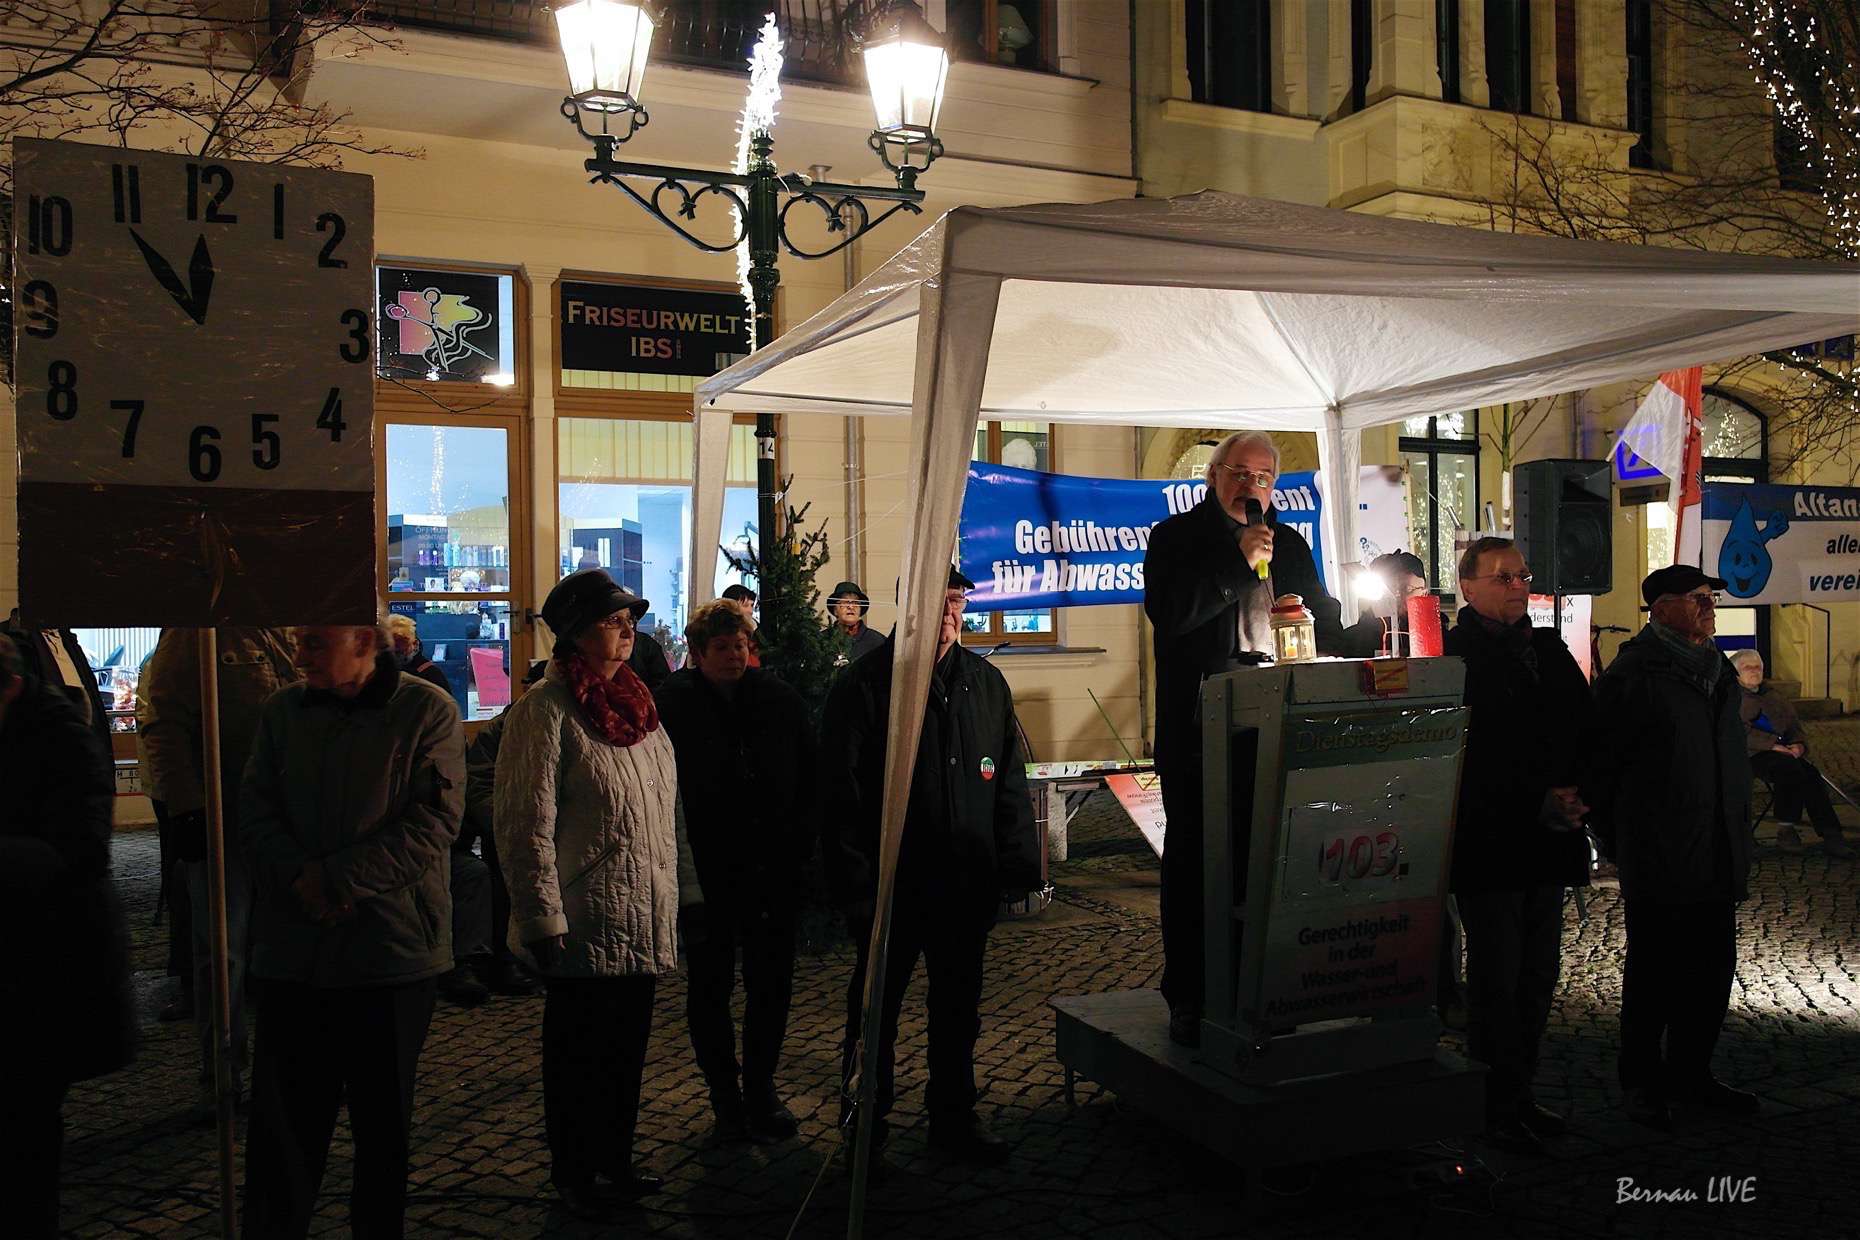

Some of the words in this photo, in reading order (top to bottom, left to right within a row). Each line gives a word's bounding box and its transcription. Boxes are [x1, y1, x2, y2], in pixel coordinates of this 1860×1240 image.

[112, 163, 141, 223] 11
[186, 163, 237, 223] 12
[274, 183, 284, 239] 1
[29, 193, 73, 256] 10
[316, 212, 348, 268] 2
[22, 280, 59, 339] 9
[339, 309, 370, 363] 3
[567, 301, 741, 334] FRISEURWELT
[47, 360, 77, 420] 8
[316, 387, 347, 442] 4
[110, 400, 144, 458] 7
[188, 426, 221, 482] 6
[252, 414, 281, 470] 5
[1270, 485, 1316, 512] ent
[1793, 491, 1860, 517] Altan
[1015, 519, 1160, 554] Gebühren
[1826, 534, 1860, 555] alle
[992, 559, 1036, 594] für
[1040, 558, 1145, 592] Abwass
[1298, 914, 1410, 945] Gerechtigkeit
[1328, 946, 1345, 962] in
[1347, 942, 1377, 960] der
